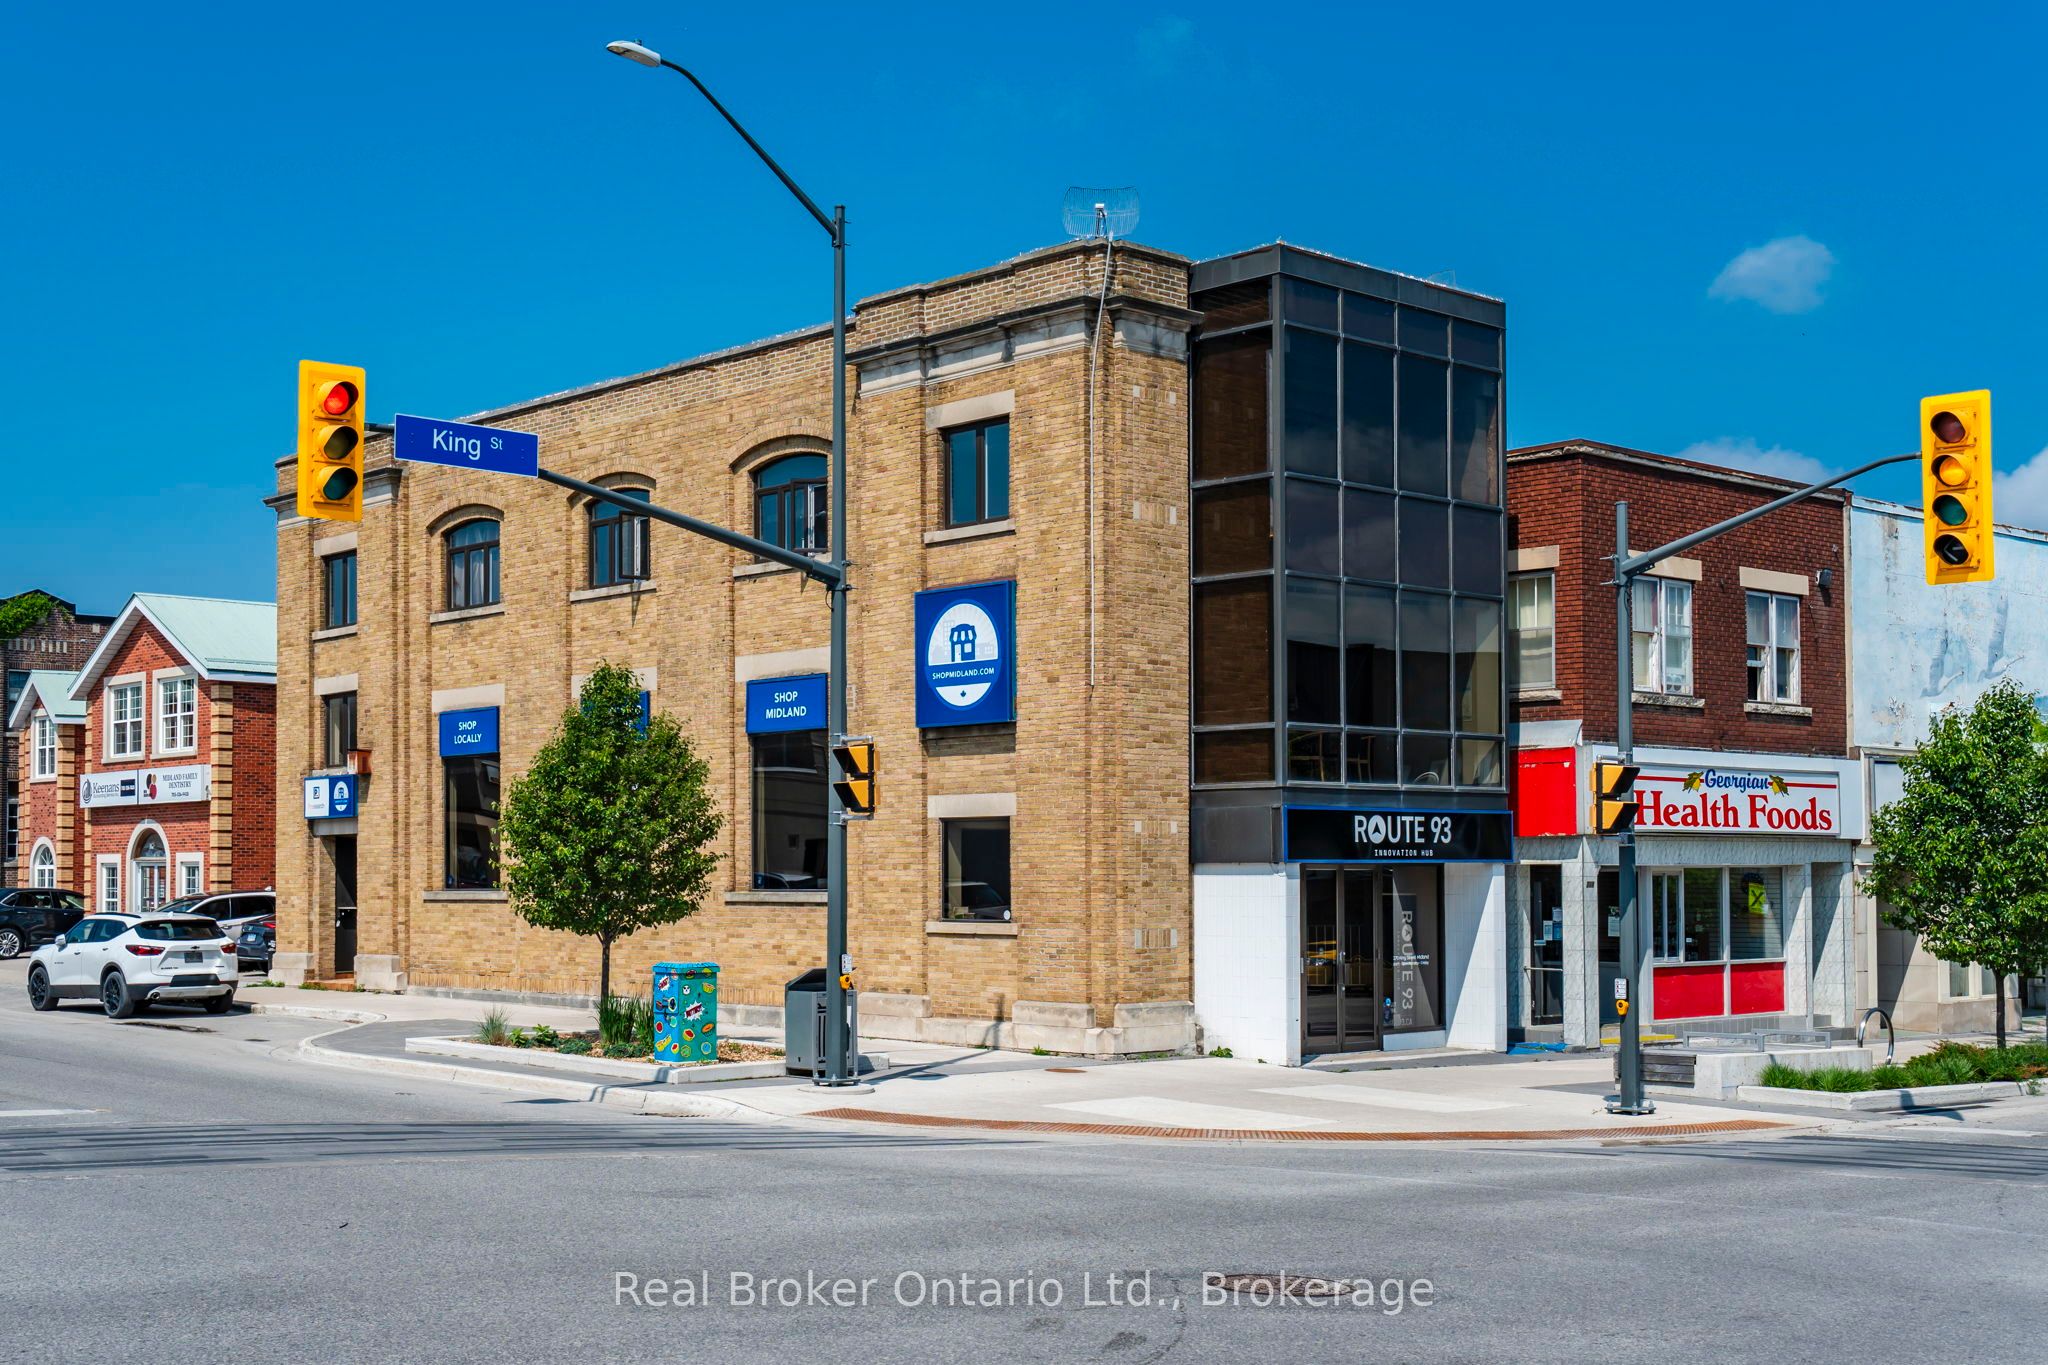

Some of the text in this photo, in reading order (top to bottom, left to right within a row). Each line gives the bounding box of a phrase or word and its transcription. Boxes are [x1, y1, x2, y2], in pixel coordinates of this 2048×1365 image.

[432, 428, 503, 460] King St
[932, 667, 995, 680] SHOPMIDLAND.COM
[773, 690, 798, 705] SHOP
[765, 704, 807, 720] MIDLAND
[457, 720, 477, 731] SHOP
[453, 733, 482, 746] LOCALLY
[92, 782, 120, 794] Keenans
[1704, 768, 1769, 793] Georgian
[1634, 790, 1832, 831] Health Foods
[1354, 814, 1452, 844] ROUTE 93
[1374, 849, 1434, 857] INNOVATION HUB
[1402, 987, 1414, 1010] 93
